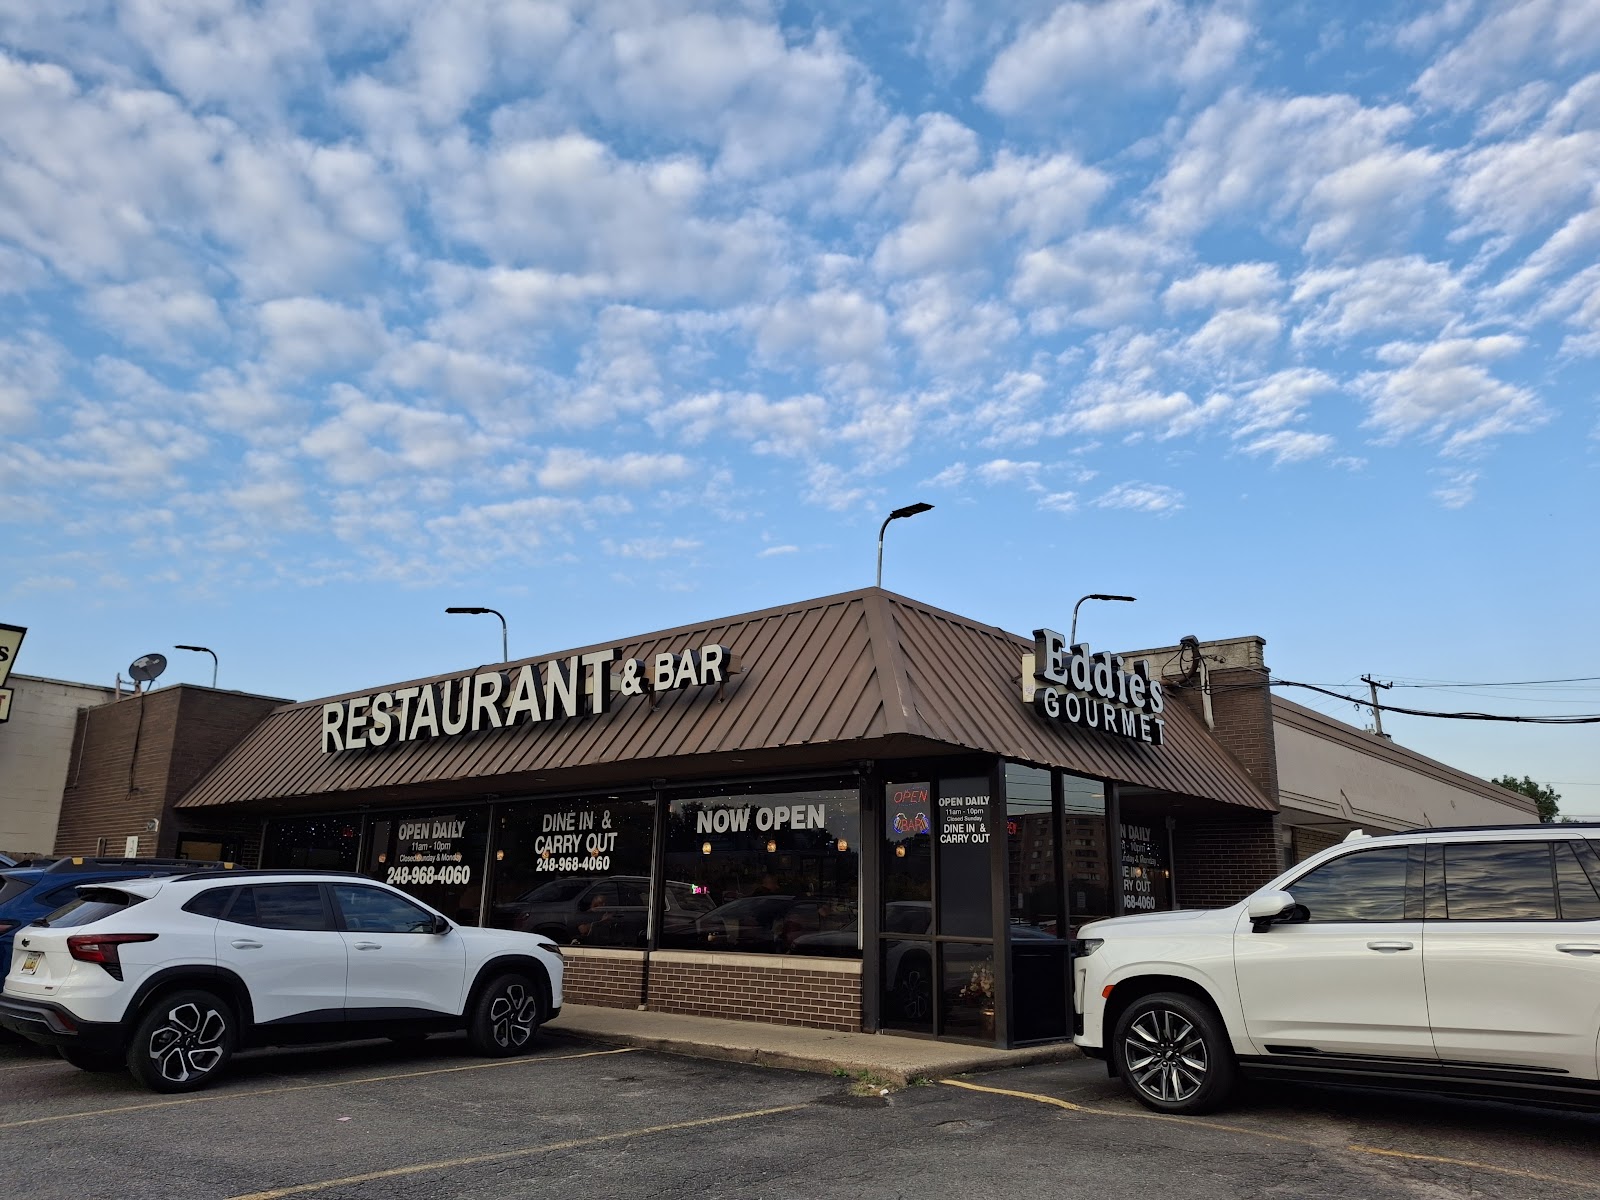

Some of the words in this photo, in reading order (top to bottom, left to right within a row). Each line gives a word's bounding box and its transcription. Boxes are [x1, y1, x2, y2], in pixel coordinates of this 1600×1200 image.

[1044, 628, 1165, 714] Eddie's
[322, 649, 615, 754] RESTAURANT
[620, 658, 643, 696] &
[655, 644, 724, 691] BAR
[1044, 687, 1165, 746] GOURMET
[894, 789, 929, 804] OPEN
[938, 798, 964, 807] OPEN
[965, 796, 990, 806] DAILY
[696, 808, 750, 834] NOW
[755, 804, 826, 831] OPEN
[967, 807, 984, 815] 10pm
[542, 812, 576, 832] DINE
[579, 811, 594, 830] IN
[601, 810, 612, 829] &
[943, 823, 964, 834] DINE
[966, 823, 975, 833] IN
[979, 823, 986, 833] &
[398, 823, 430, 840] OPEN
[432, 821, 466, 839] DAILY
[940, 834, 969, 844] CARRY
[971, 833, 990, 843] OUT
[1129, 825, 1151, 841] DAILY
[411, 841, 428, 851] 11am
[433, 841, 451, 852] 10pm
[535, 833, 582, 854] CARRY
[585, 832, 618, 853] OUT
[416, 853, 436, 863] unday
[441, 853, 462, 863] Mondy
[536, 856, 610, 872] 248-968-4060
[386, 865, 471, 885] 248-968-4060
[1136, 880, 1151, 892] OUT
